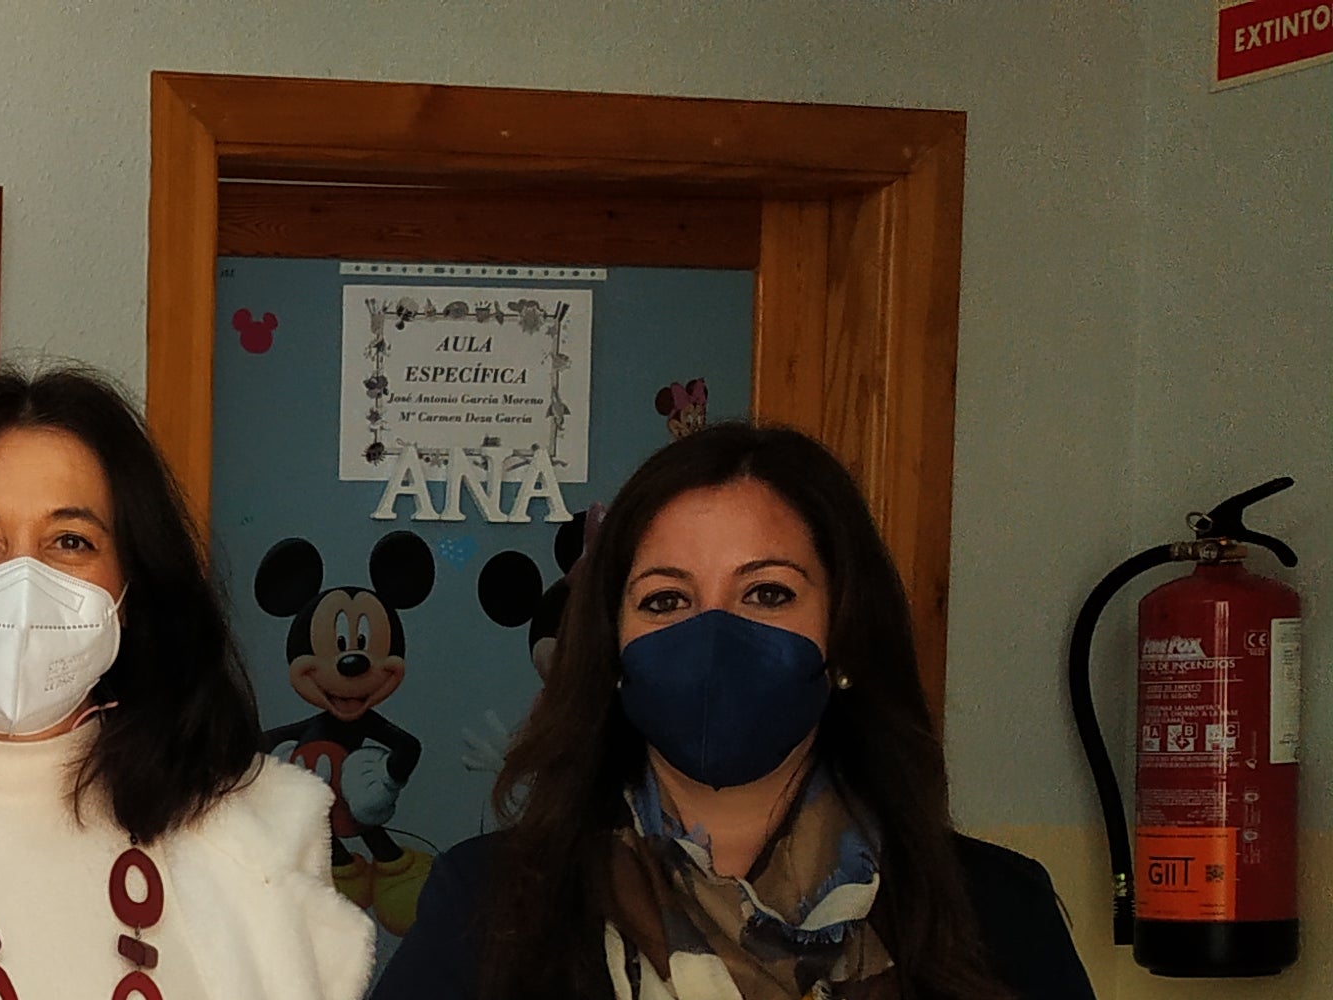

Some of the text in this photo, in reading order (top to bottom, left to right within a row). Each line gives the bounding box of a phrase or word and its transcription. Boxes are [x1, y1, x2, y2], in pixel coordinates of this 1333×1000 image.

[1235, 4, 1333, 53] EXTINTO
[435, 335, 493, 353] AULA
[405, 362, 528, 384] ESPECÍFICA
[415, 393, 458, 404] Antonio
[502, 395, 544, 406] Moreno
[418, 412, 462, 423] Carmen
[369, 444, 574, 524] ANA
[1172, 658, 1236, 671] INCENDIOS
[1184, 726, 1194, 737] B
